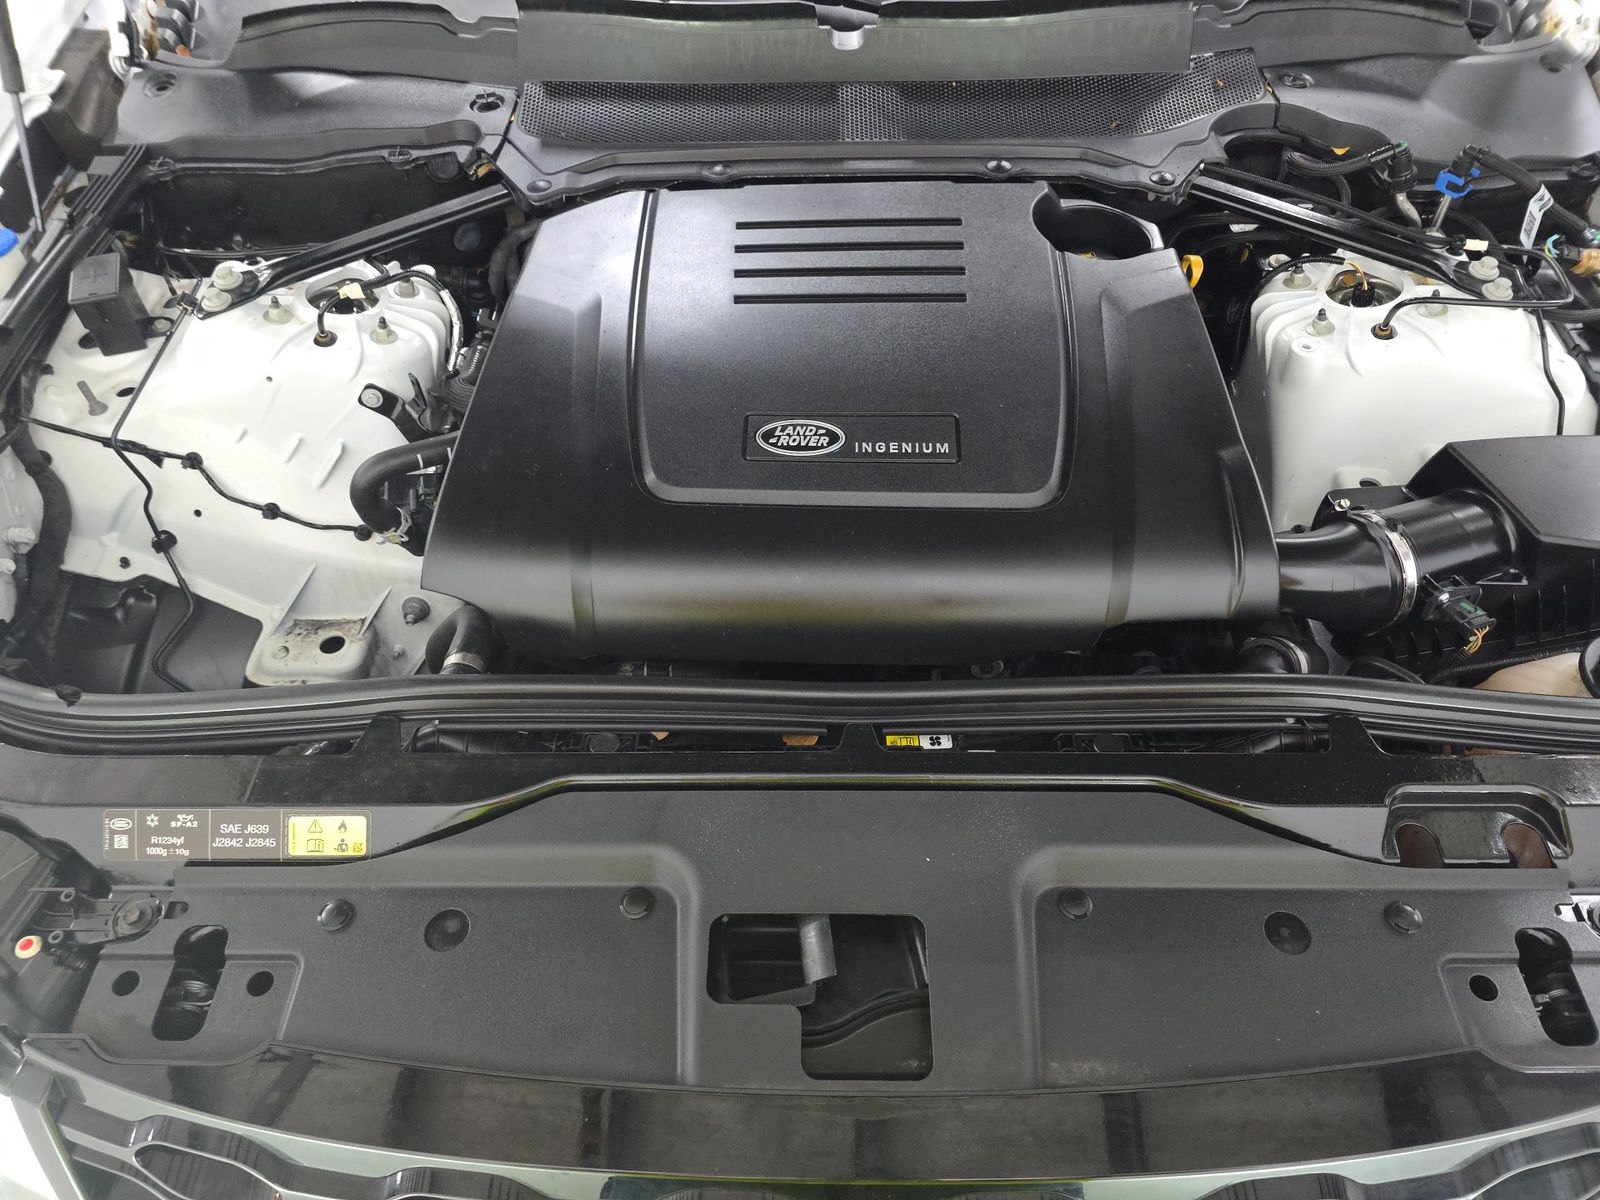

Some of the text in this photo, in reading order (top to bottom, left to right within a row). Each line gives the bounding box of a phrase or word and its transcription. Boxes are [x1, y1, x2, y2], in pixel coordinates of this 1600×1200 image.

[774, 426, 817, 436] LAND
[777, 435, 830, 447] ROVER
[855, 442, 949, 453] INGENIUM
[220, 823, 270, 834] SAE J639
[151, 836, 185, 846] R1234yf
[212, 837, 276, 848] J2842 J2845
[145, 847, 167, 856] 1000g
